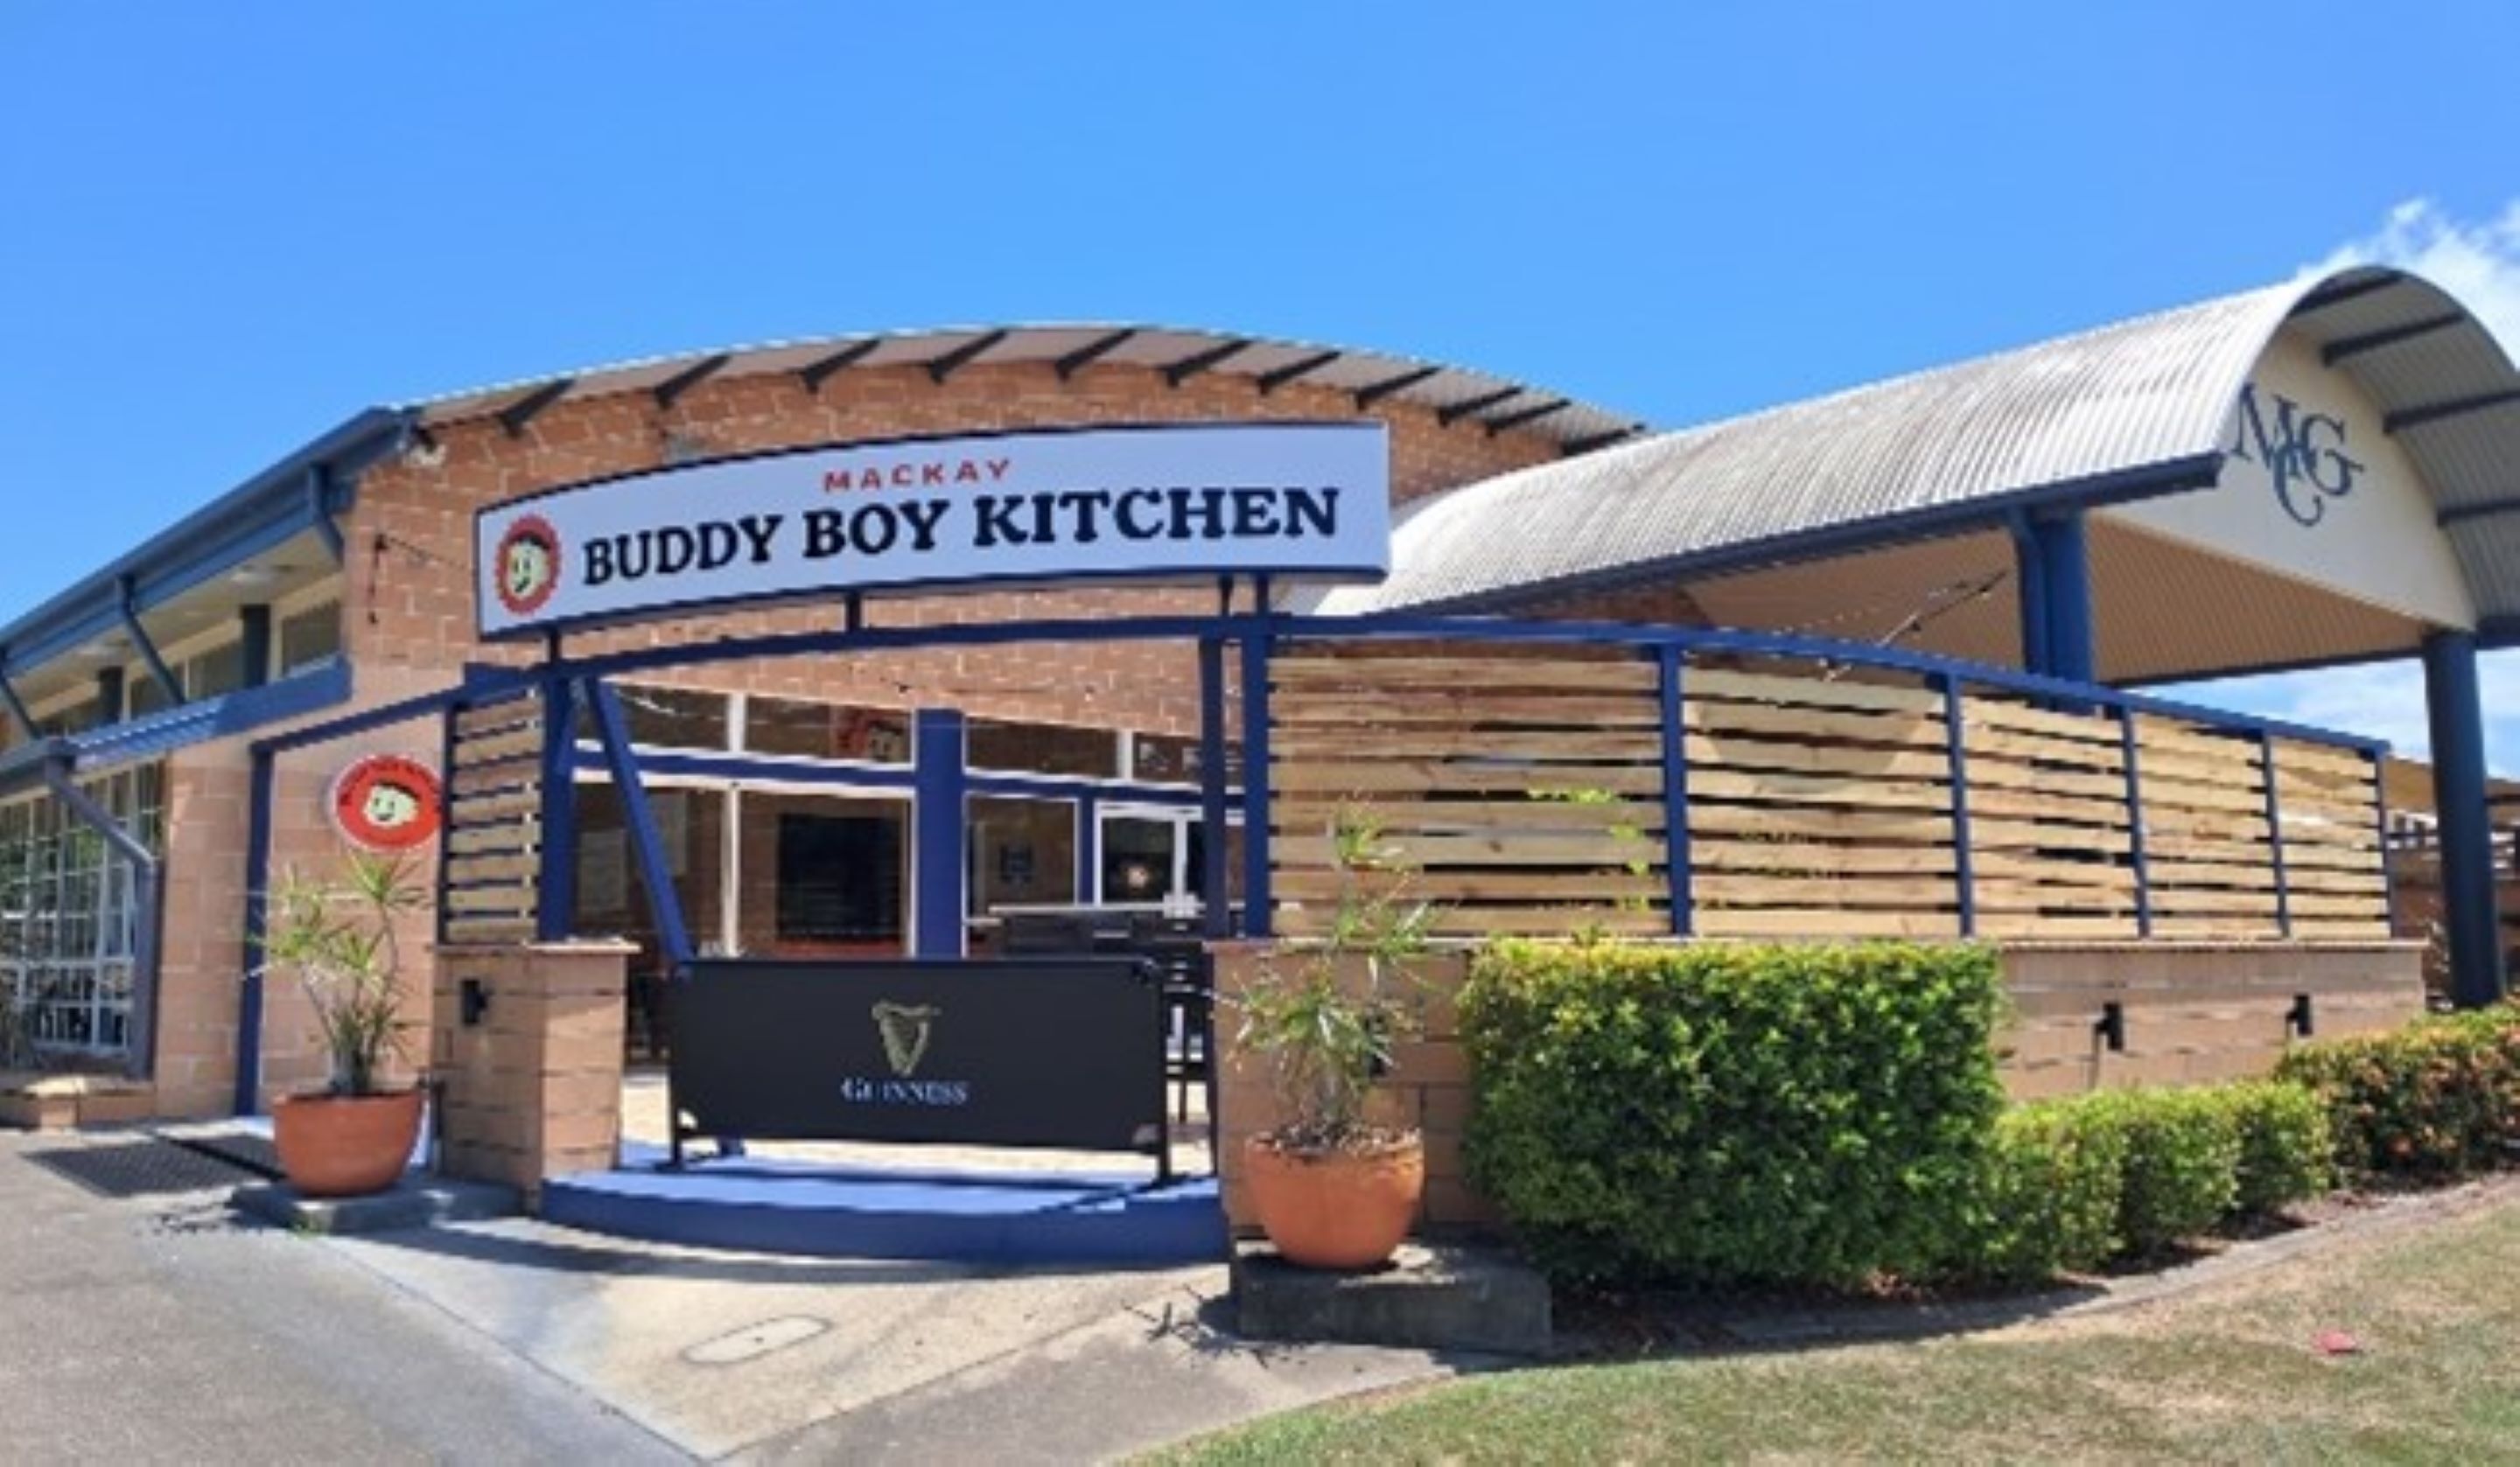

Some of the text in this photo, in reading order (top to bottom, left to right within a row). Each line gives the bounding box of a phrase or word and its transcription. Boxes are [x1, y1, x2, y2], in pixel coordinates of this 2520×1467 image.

[822, 459, 1012, 493] MACKAY
[582, 486, 1340, 587] BUDDY BOY KITCHEN
